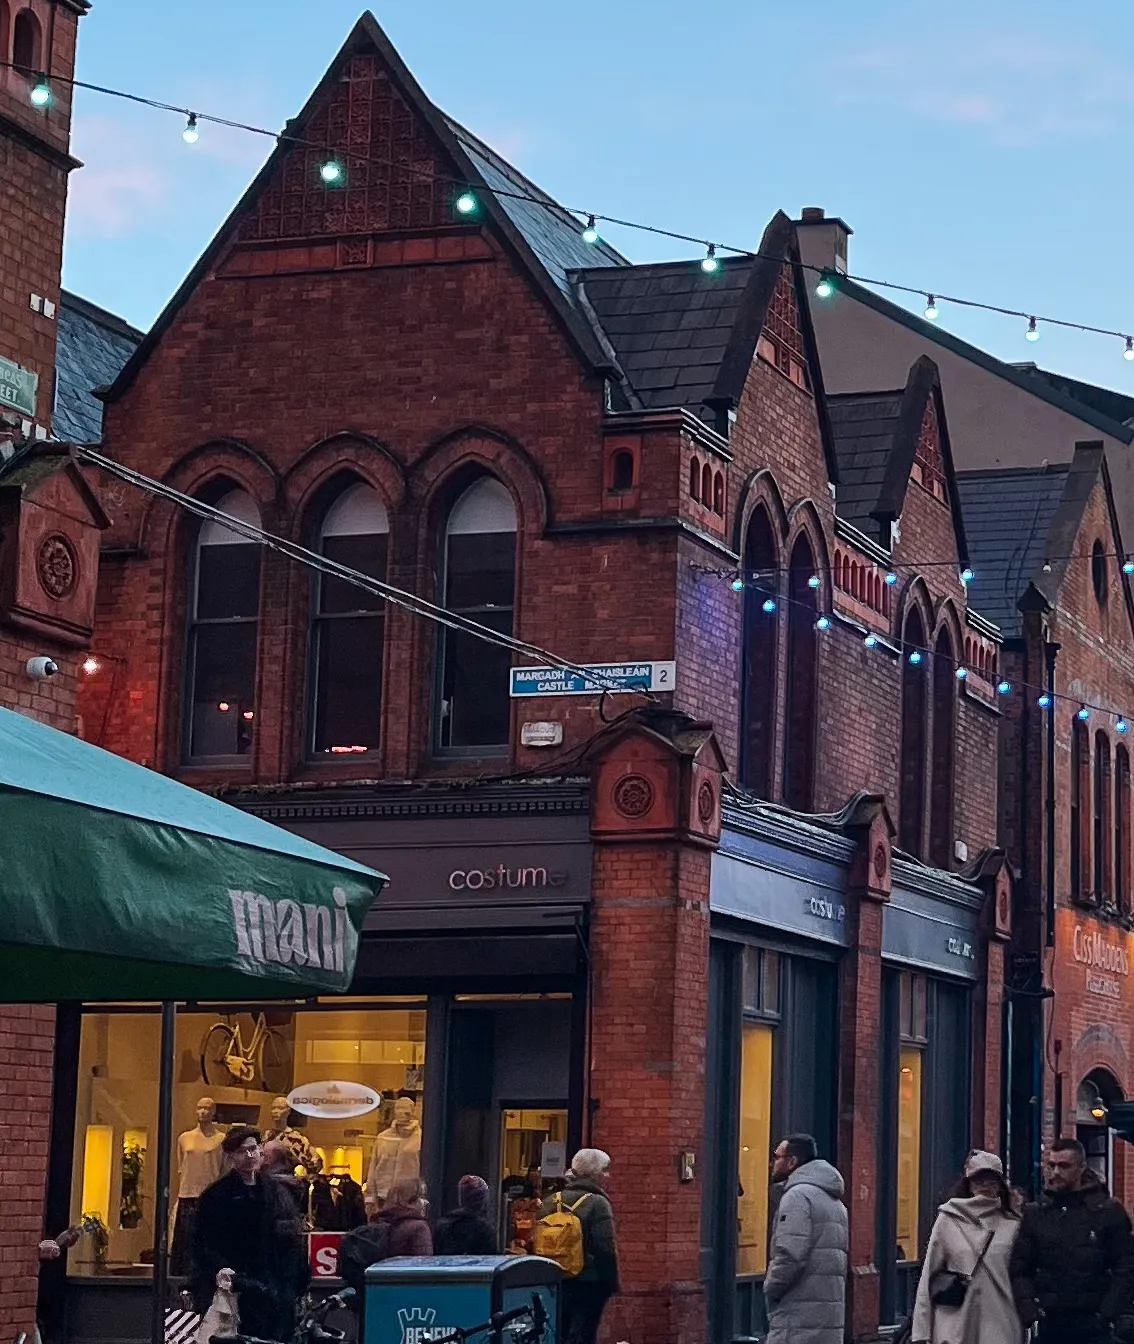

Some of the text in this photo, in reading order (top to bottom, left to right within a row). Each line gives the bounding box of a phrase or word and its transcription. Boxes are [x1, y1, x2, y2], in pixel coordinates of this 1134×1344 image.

[516, 670, 565, 682] MARGADH
[659, 669, 668, 683] 2
[537, 680, 575, 692] CASTLE
[449, 863, 568, 890] costume
[228, 894, 347, 973] mani
